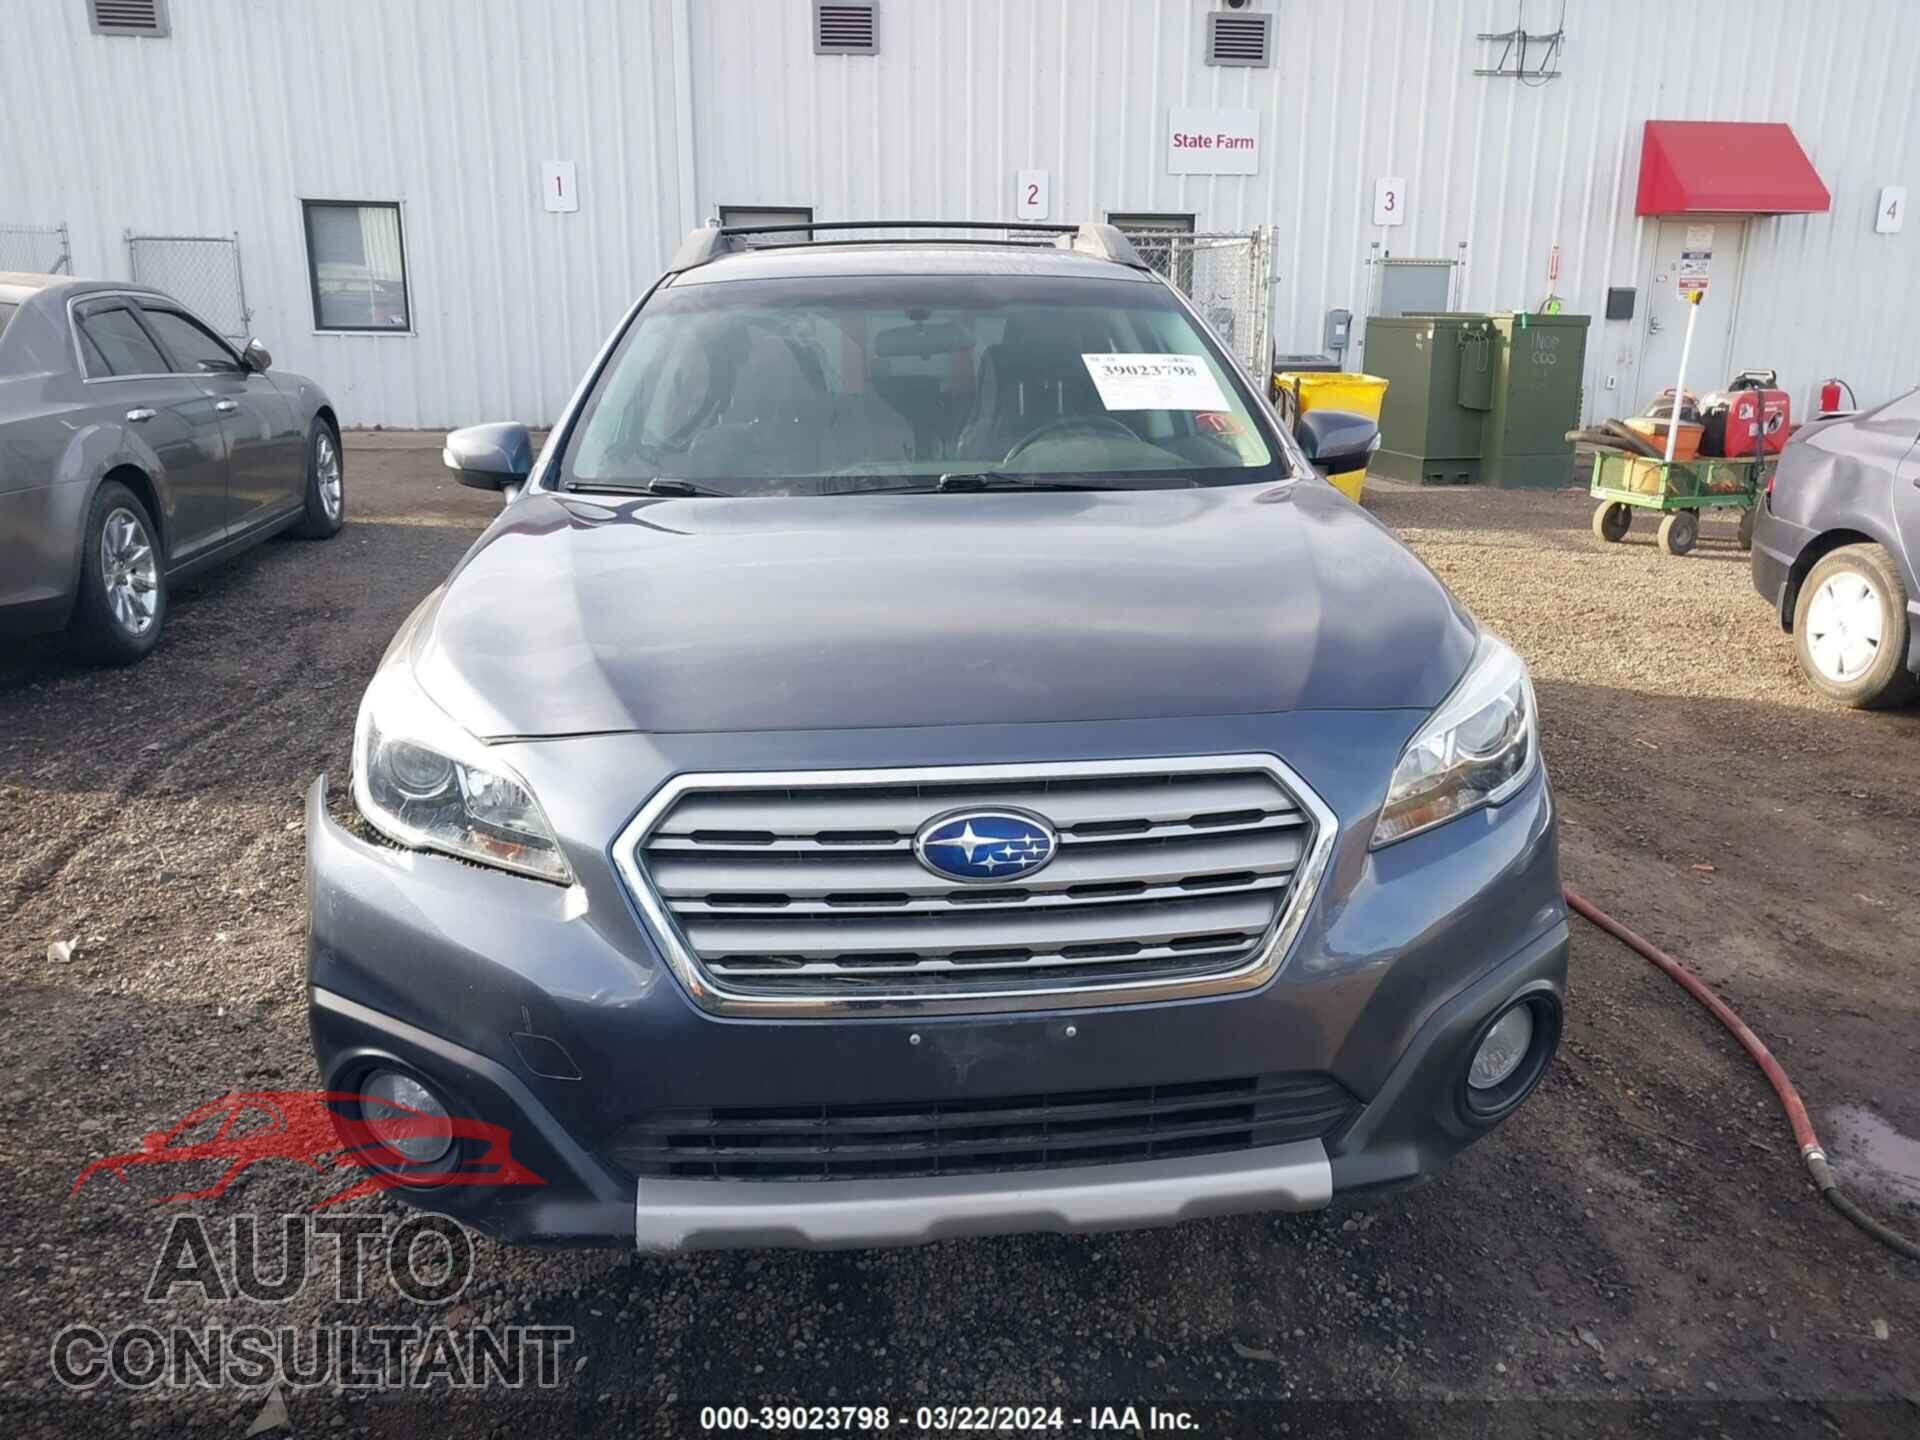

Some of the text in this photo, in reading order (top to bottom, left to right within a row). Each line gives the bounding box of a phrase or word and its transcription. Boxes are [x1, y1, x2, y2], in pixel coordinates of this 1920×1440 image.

[1173, 132, 1254, 149] State Farm
[556, 175, 563, 197] 1
[1027, 183, 1039, 205] 2
[1384, 191, 1395, 211] 3
[1886, 199, 1897, 220] 4
[1102, 364, 1198, 377] 39023798
